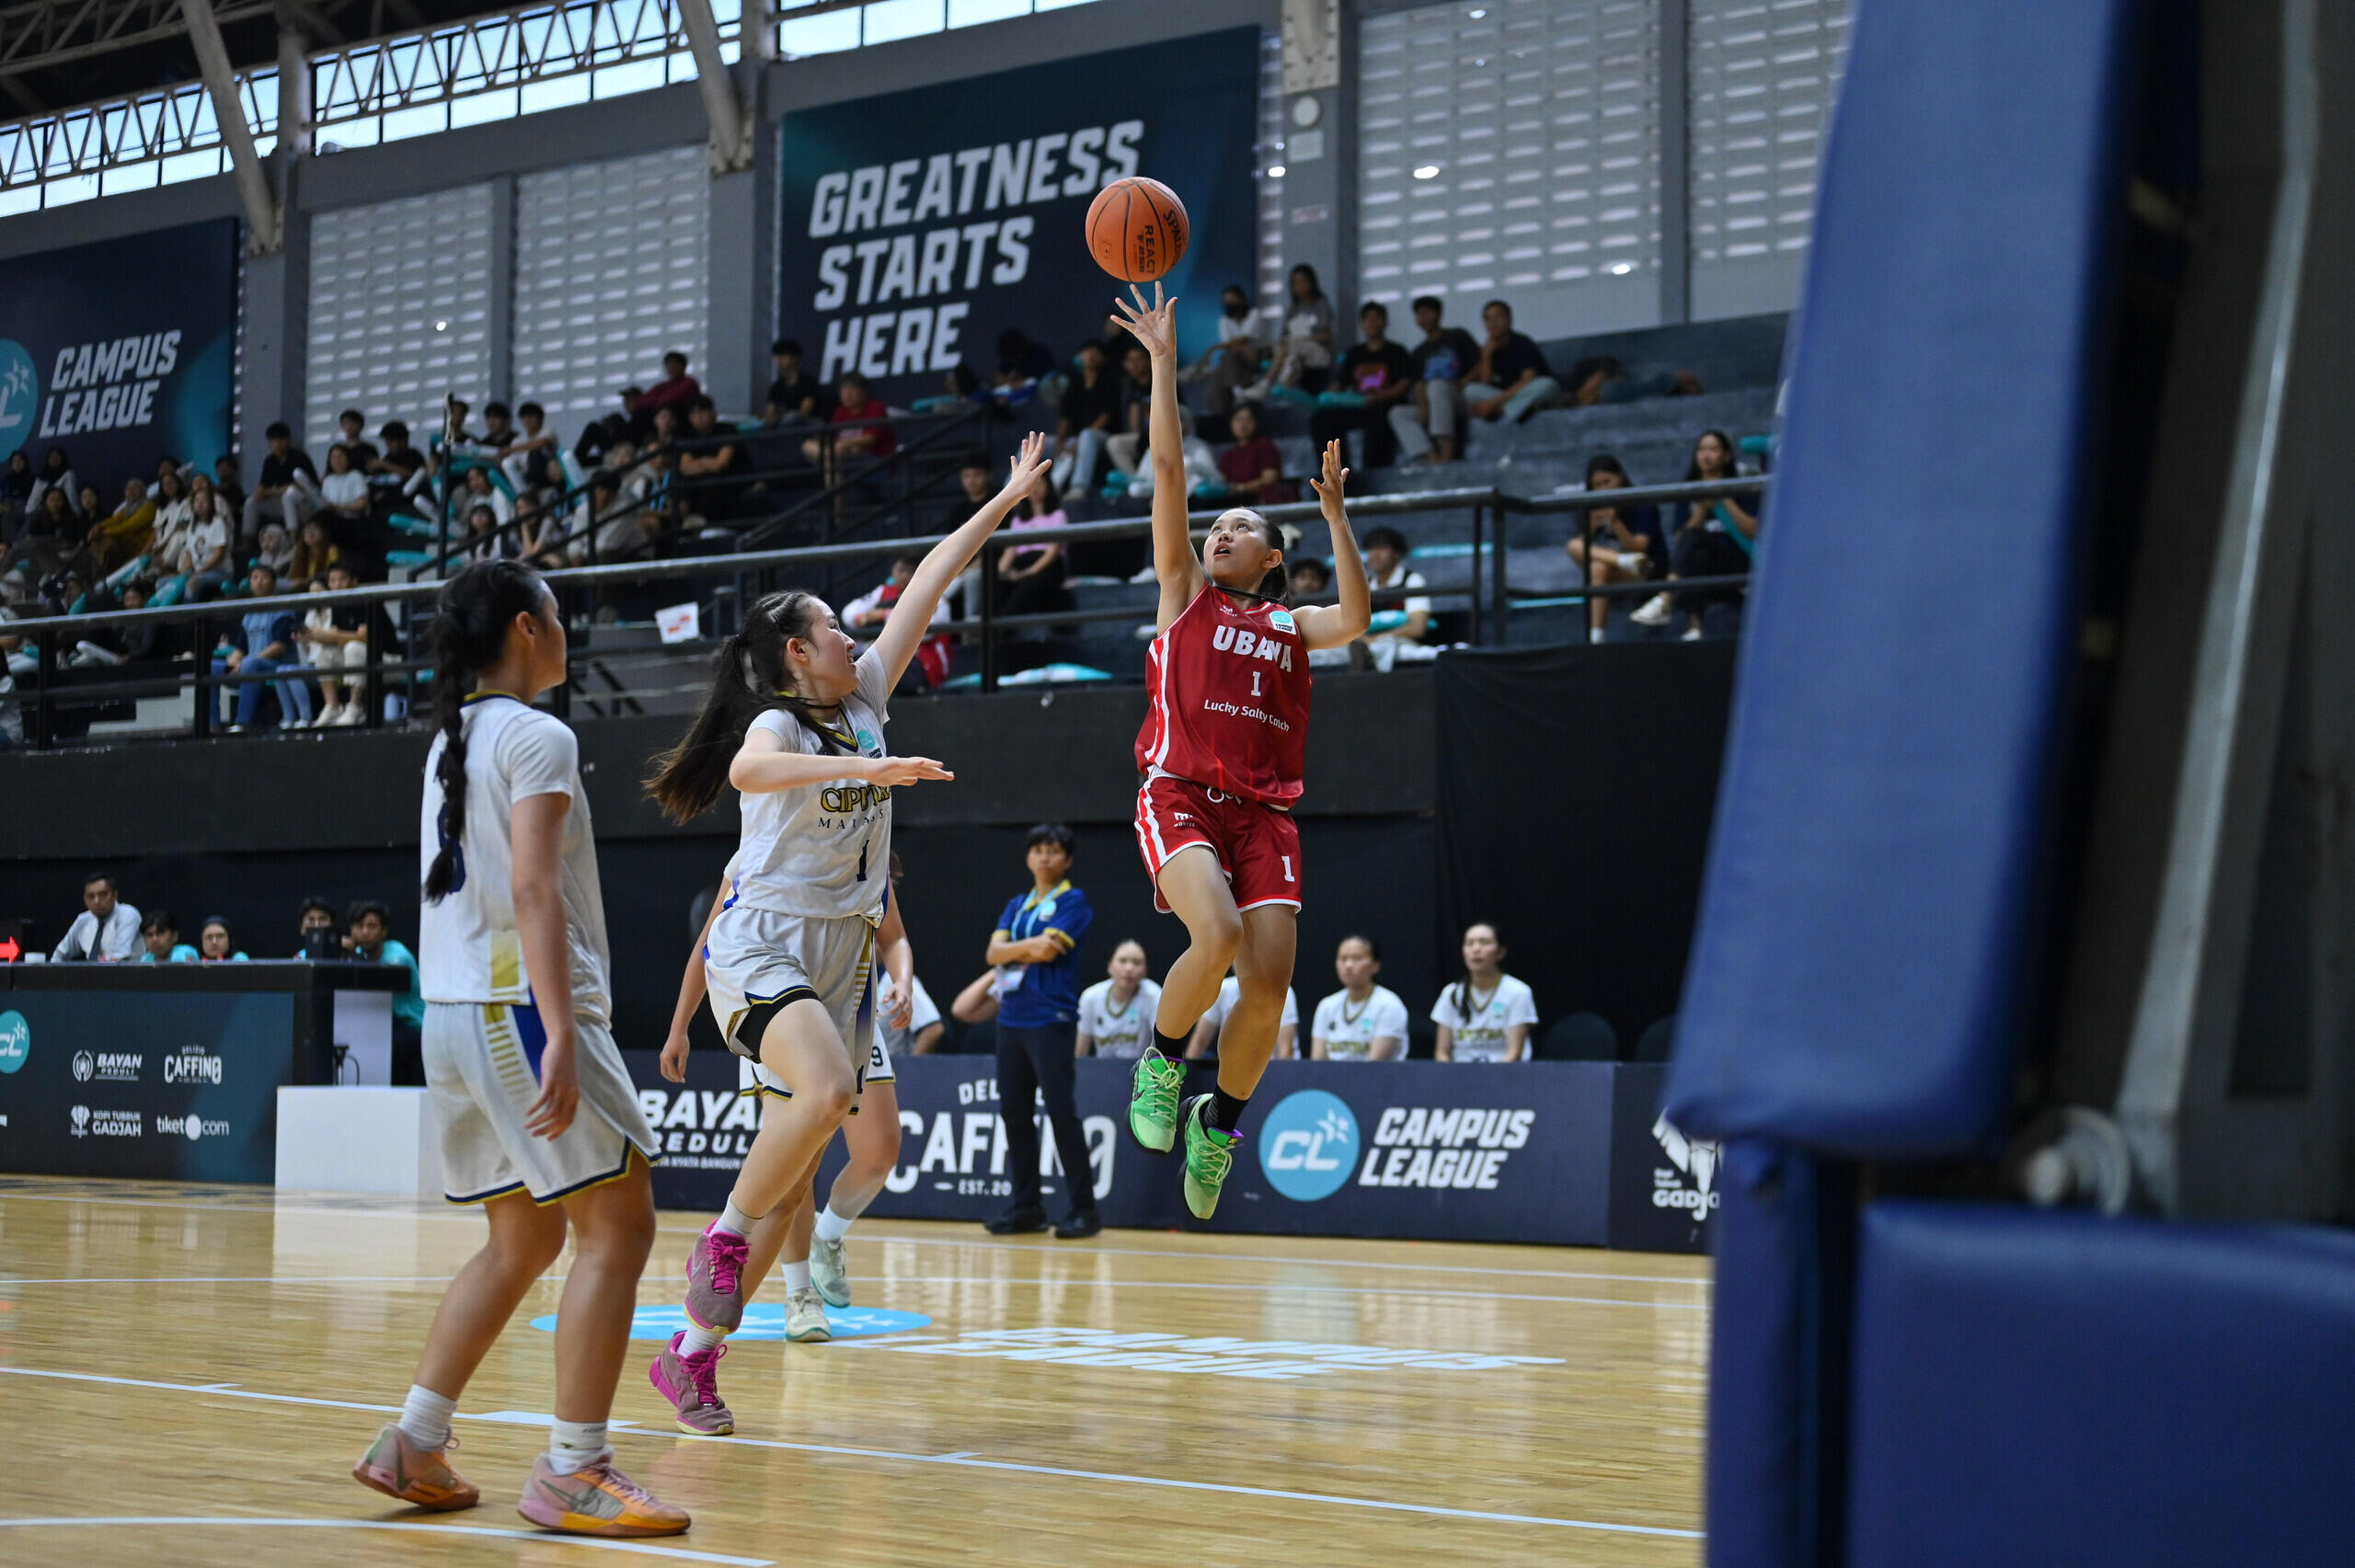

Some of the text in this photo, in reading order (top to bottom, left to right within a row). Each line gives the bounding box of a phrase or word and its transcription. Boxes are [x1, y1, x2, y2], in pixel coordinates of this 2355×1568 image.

[809, 120, 1144, 239] GREATNESS
[813, 216, 1034, 311] STARTS
[1144, 225, 1155, 274] REACT
[51, 329, 181, 392] CAMPUS
[819, 302, 970, 384] HERE
[39, 379, 161, 439] LEAGUE
[1251, 670, 1261, 697] 1
[1204, 699, 1239, 716] Lucky
[1241, 705, 1268, 723] Salty
[856, 840, 869, 882] 1
[1281, 855, 1295, 882] 1
[97, 1053, 143, 1069] BAYAN
[92, 1120, 142, 1138] GADJAH
[93, 1109, 110, 1120] KOPI
[638, 1089, 764, 1131] BAYA
[1373, 1107, 1535, 1150] CAMPUS
[1269, 1129, 1339, 1171] CL
[1358, 1147, 1509, 1189] LEAGUE
